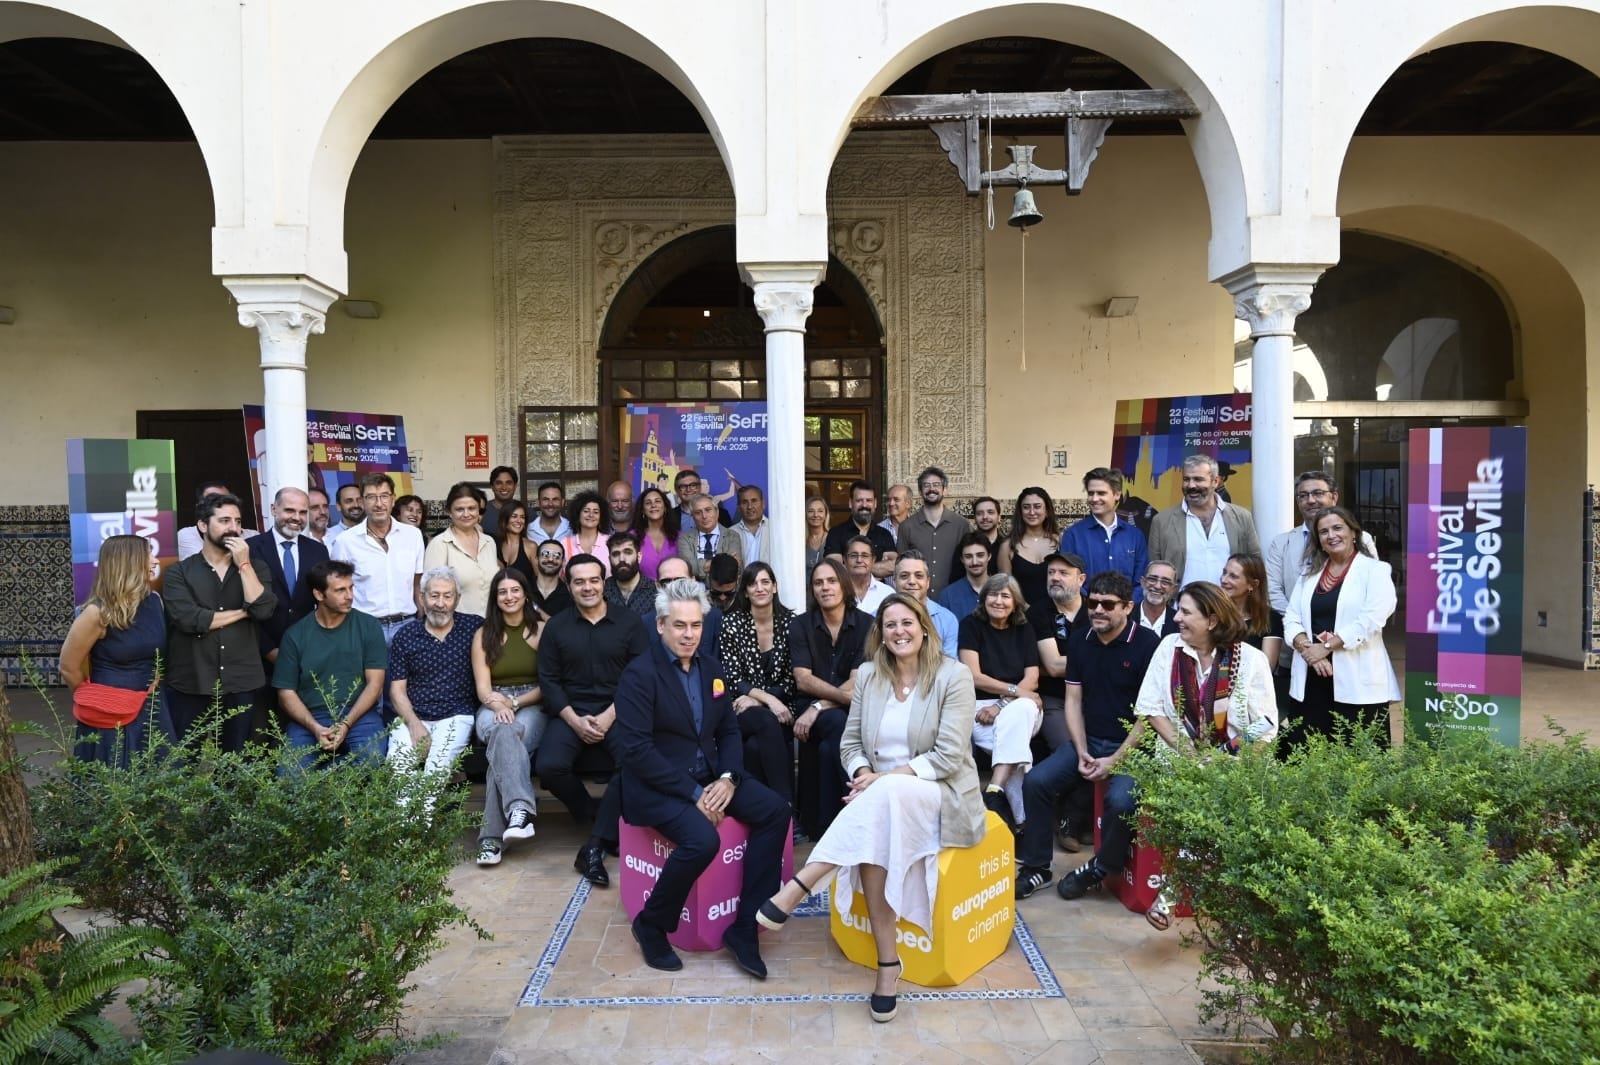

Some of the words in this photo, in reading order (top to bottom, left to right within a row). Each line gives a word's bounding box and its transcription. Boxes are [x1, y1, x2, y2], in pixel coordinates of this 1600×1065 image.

[1169, 408, 1182, 417] 22
[1182, 406, 1216, 416] Festival
[1219, 405, 1253, 422] SeF
[680, 414, 693, 422] 22
[693, 413, 725, 422] Festival
[1169, 417, 1181, 425] de
[1183, 416, 1214, 424] Sevilla
[306, 421, 319, 430] 22
[319, 422, 351, 432] Festival
[681, 422, 693, 430] de
[694, 421, 724, 430] Sevilla
[308, 430, 320, 438] de
[321, 430, 352, 440] Sevilla
[355, 424, 396, 441] SeFF
[1213, 429, 1229, 437] cine
[697, 435, 713, 443] esto
[739, 436, 768, 444] europe
[1219, 437, 1240, 445] 2025
[368, 447, 399, 456] europeo
[729, 443, 749, 451] 2025
[360, 454, 379, 462] 2025
[1465, 457, 1504, 580] Sevilla
[1427, 503, 1465, 634] Festival
[1465, 587, 1502, 637] de
[979, 857, 1000, 879] this
[1001, 849, 1010, 866] is
[952, 876, 1010, 921] european
[967, 906, 1010, 943] cinema
